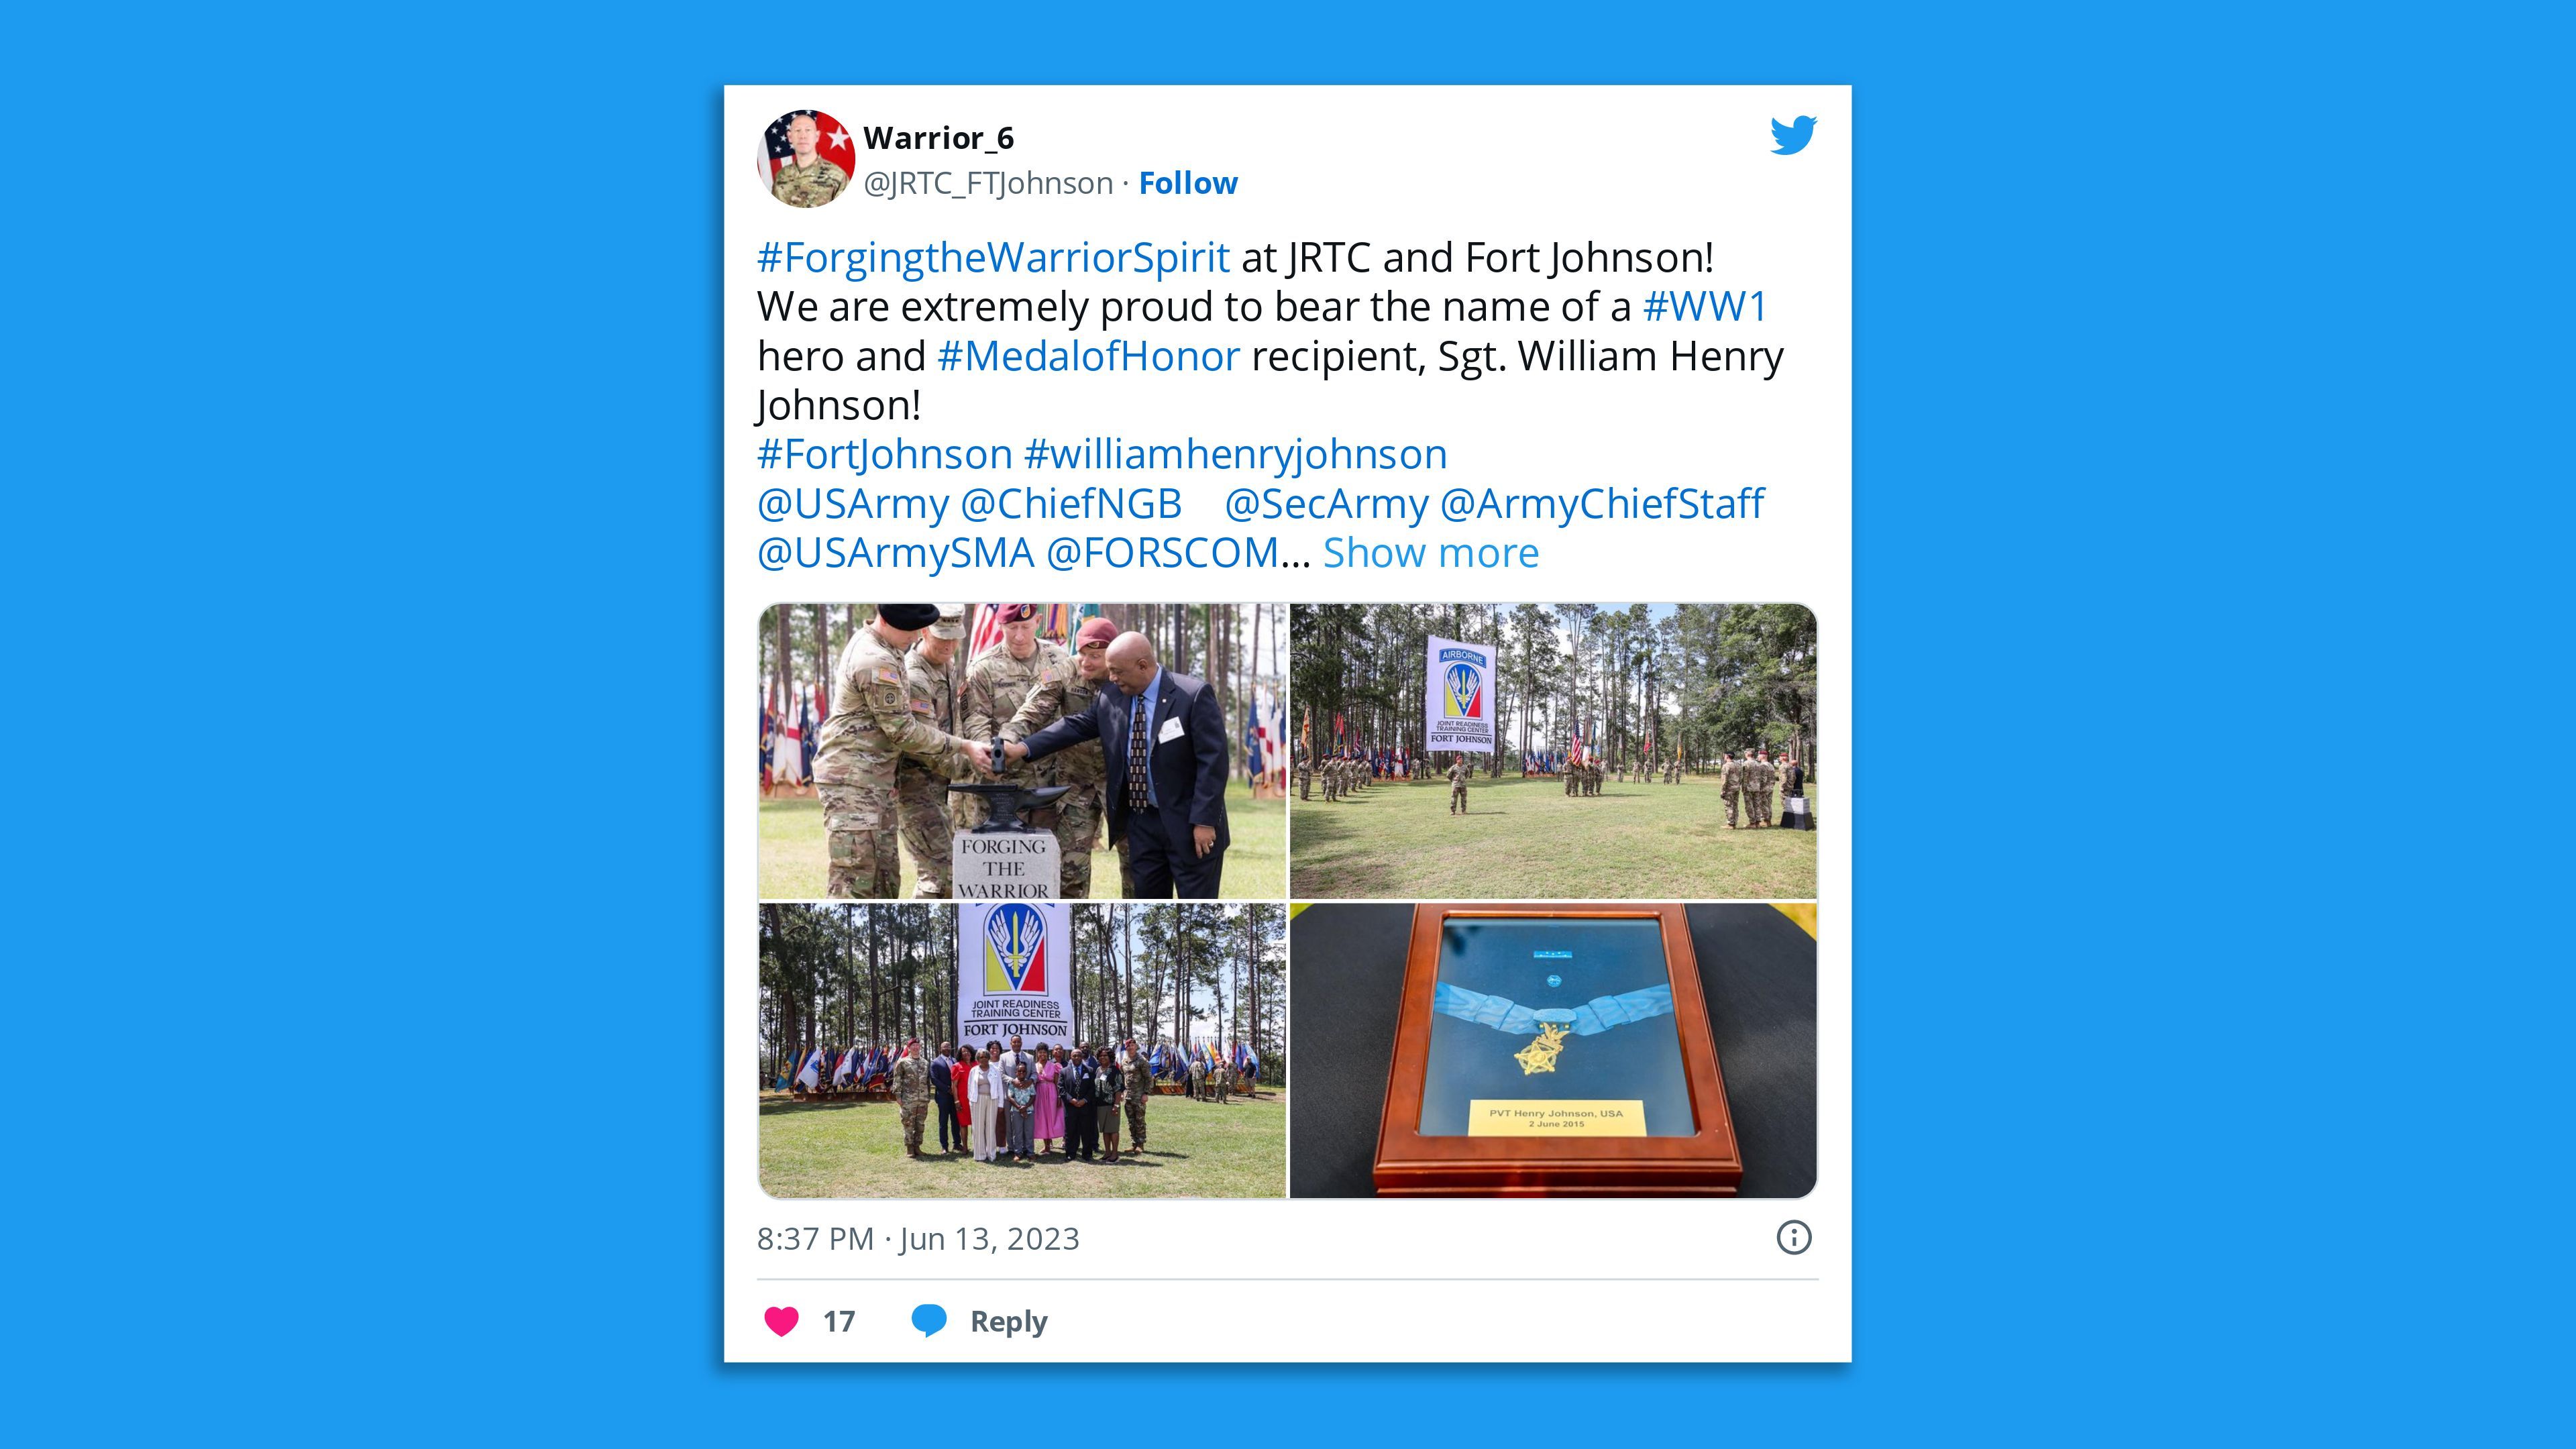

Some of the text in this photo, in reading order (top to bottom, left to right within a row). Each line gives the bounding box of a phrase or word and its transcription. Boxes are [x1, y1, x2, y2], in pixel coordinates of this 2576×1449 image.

[863, 125, 1014, 154] Warrior_6
[864, 170, 1239, 200] @JRTC_FTJohnson Follow
[757, 240, 1713, 282] #ForgingtheWarriorSpirit at JRTC and Fort Johnson!
[757, 290, 1763, 331] We are extremely proud to bear the name of a #WW1
[759, 339, 1785, 381] hero and #MedalofHonor recipient, Sgt. William Henry
[753, 388, 920, 427] Johnson!
[757, 437, 1446, 479] #FortJohnson #williamhenryjohnson
[758, 486, 1767, 528] @USArmy @ChiefNGB @SecArmy @ArmyChiefStaff
[758, 537, 1035, 578] @USArmySMA
[1324, 535, 1426, 568] Show
[1440, 544, 1539, 568] more
[1442, 650, 1484, 665] AIRBORNE
[1431, 735, 1492, 744] FORT JOHNSON
[961, 839, 1046, 854] FORGING
[983, 861, 1025, 877] THE
[958, 883, 1050, 899] WARRIOR
[971, 1009, 1061, 1018] TRAINING CENTER
[973, 1000, 1060, 1010] JOINT READINESS
[964, 1023, 1068, 1037] FORT JOHNSON
[1489, 1109, 1623, 1119] PVT Henry Johnson, USA
[757, 1227, 1079, 1256] 8:37 PM Jun 13, 2023
[824, 1310, 855, 1332] 17
[972, 1309, 1049, 1338] Reply
